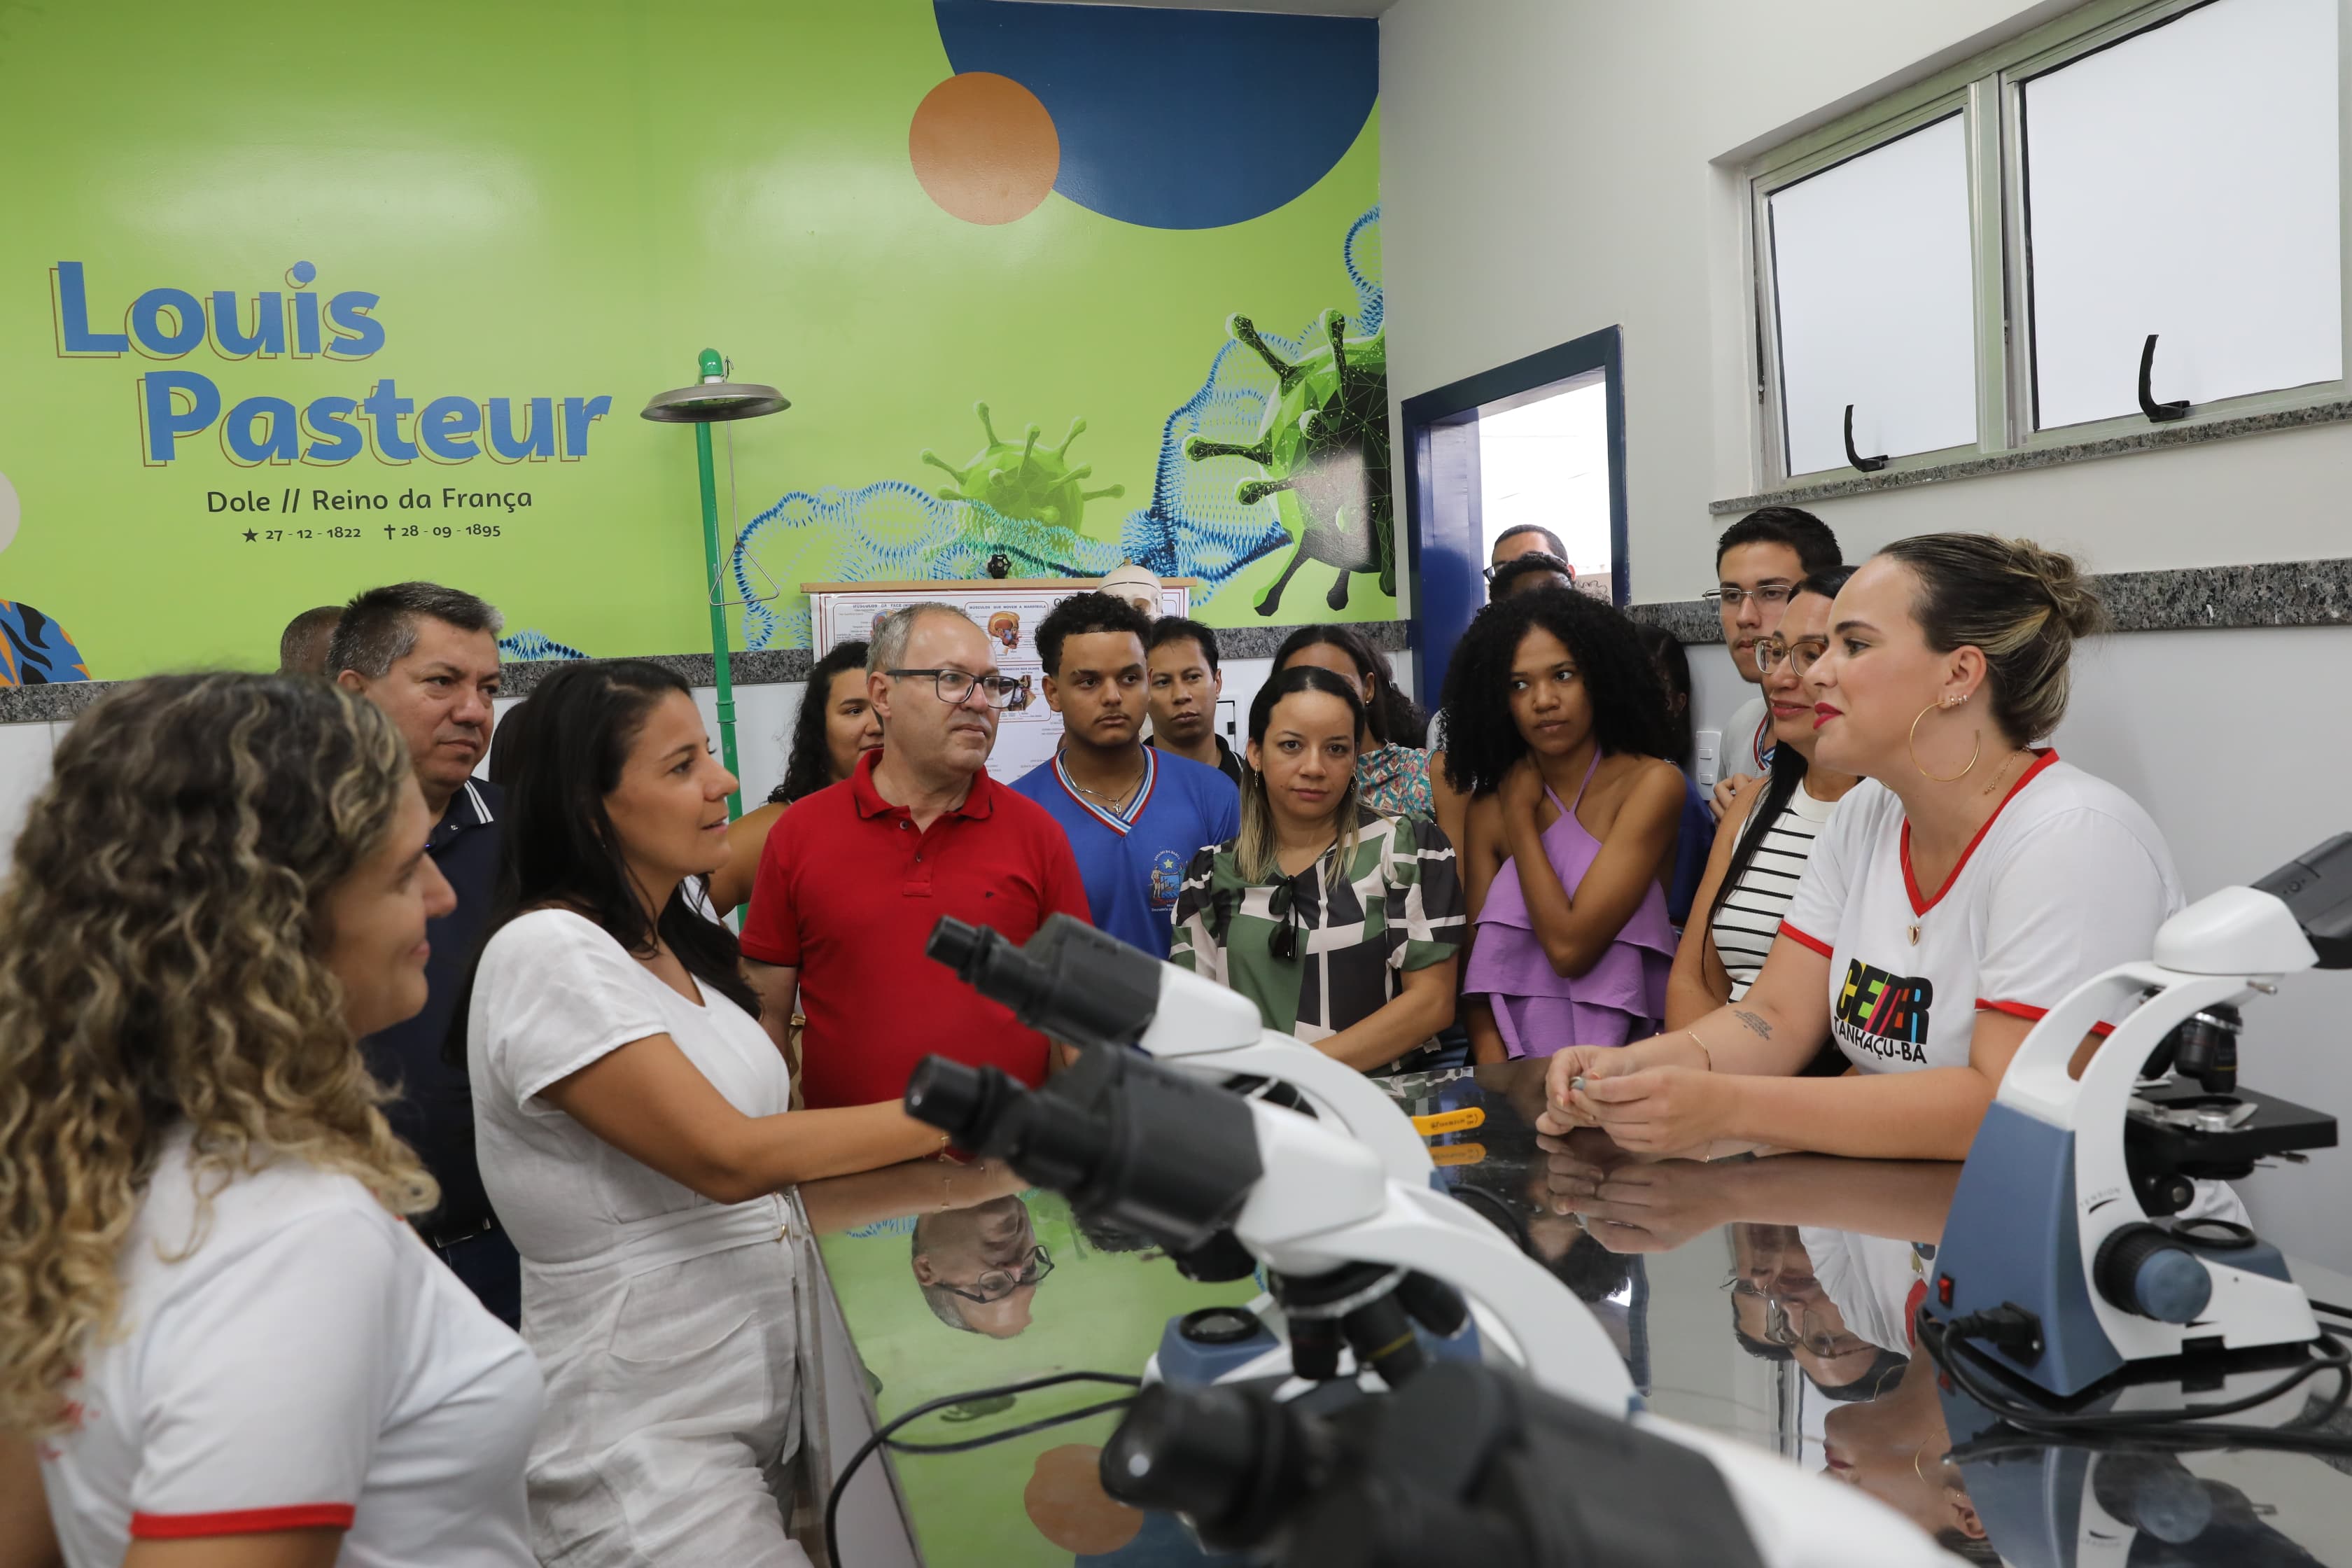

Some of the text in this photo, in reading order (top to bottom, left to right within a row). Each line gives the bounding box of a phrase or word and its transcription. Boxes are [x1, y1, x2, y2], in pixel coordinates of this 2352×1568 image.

[50, 261, 385, 361] Louis
[137, 370, 612, 467] Pasteur
[207, 490, 270, 512] Dole
[313, 489, 388, 510] Reino
[398, 488, 431, 509] da
[442, 488, 532, 513] França
[265, 530, 283, 542] 27
[296, 529, 313, 539] 12
[326, 526, 361, 538] 1822
[401, 525, 419, 537] 28
[433, 526, 451, 538] 09
[465, 524, 500, 538] 1895
[1834, 1016, 1927, 1064] TANHAÇU-BA
